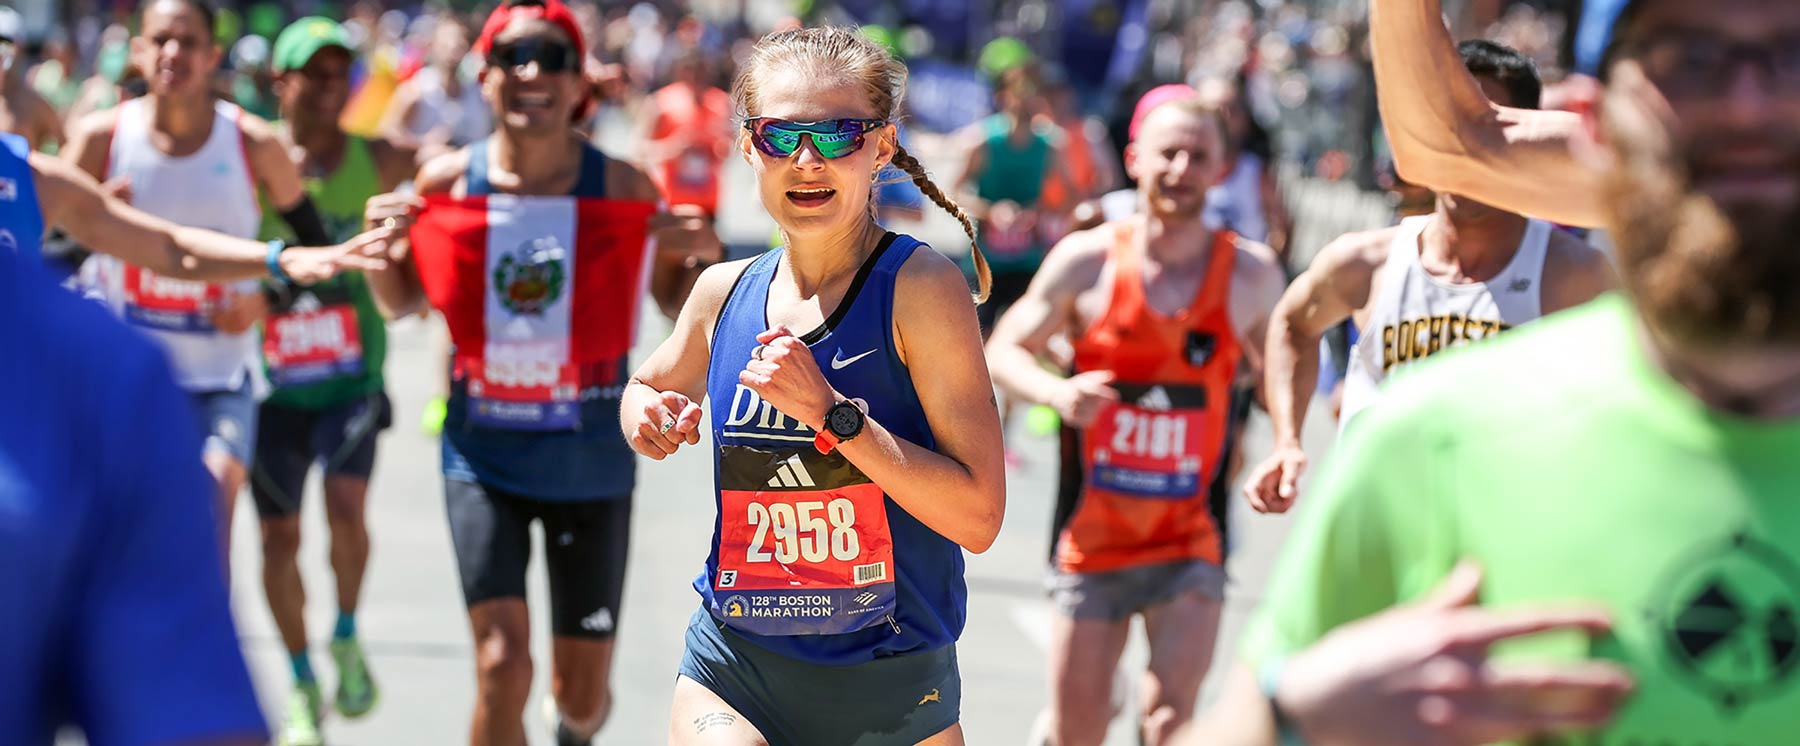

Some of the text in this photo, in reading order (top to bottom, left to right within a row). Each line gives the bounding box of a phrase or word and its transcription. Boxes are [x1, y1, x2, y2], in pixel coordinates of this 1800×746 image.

[1111, 409, 1187, 459] 2181
[745, 497, 861, 565] 2958
[721, 572, 735, 586] 3
[779, 595, 832, 607] BOSTON
[752, 607, 833, 618] MARATHON
